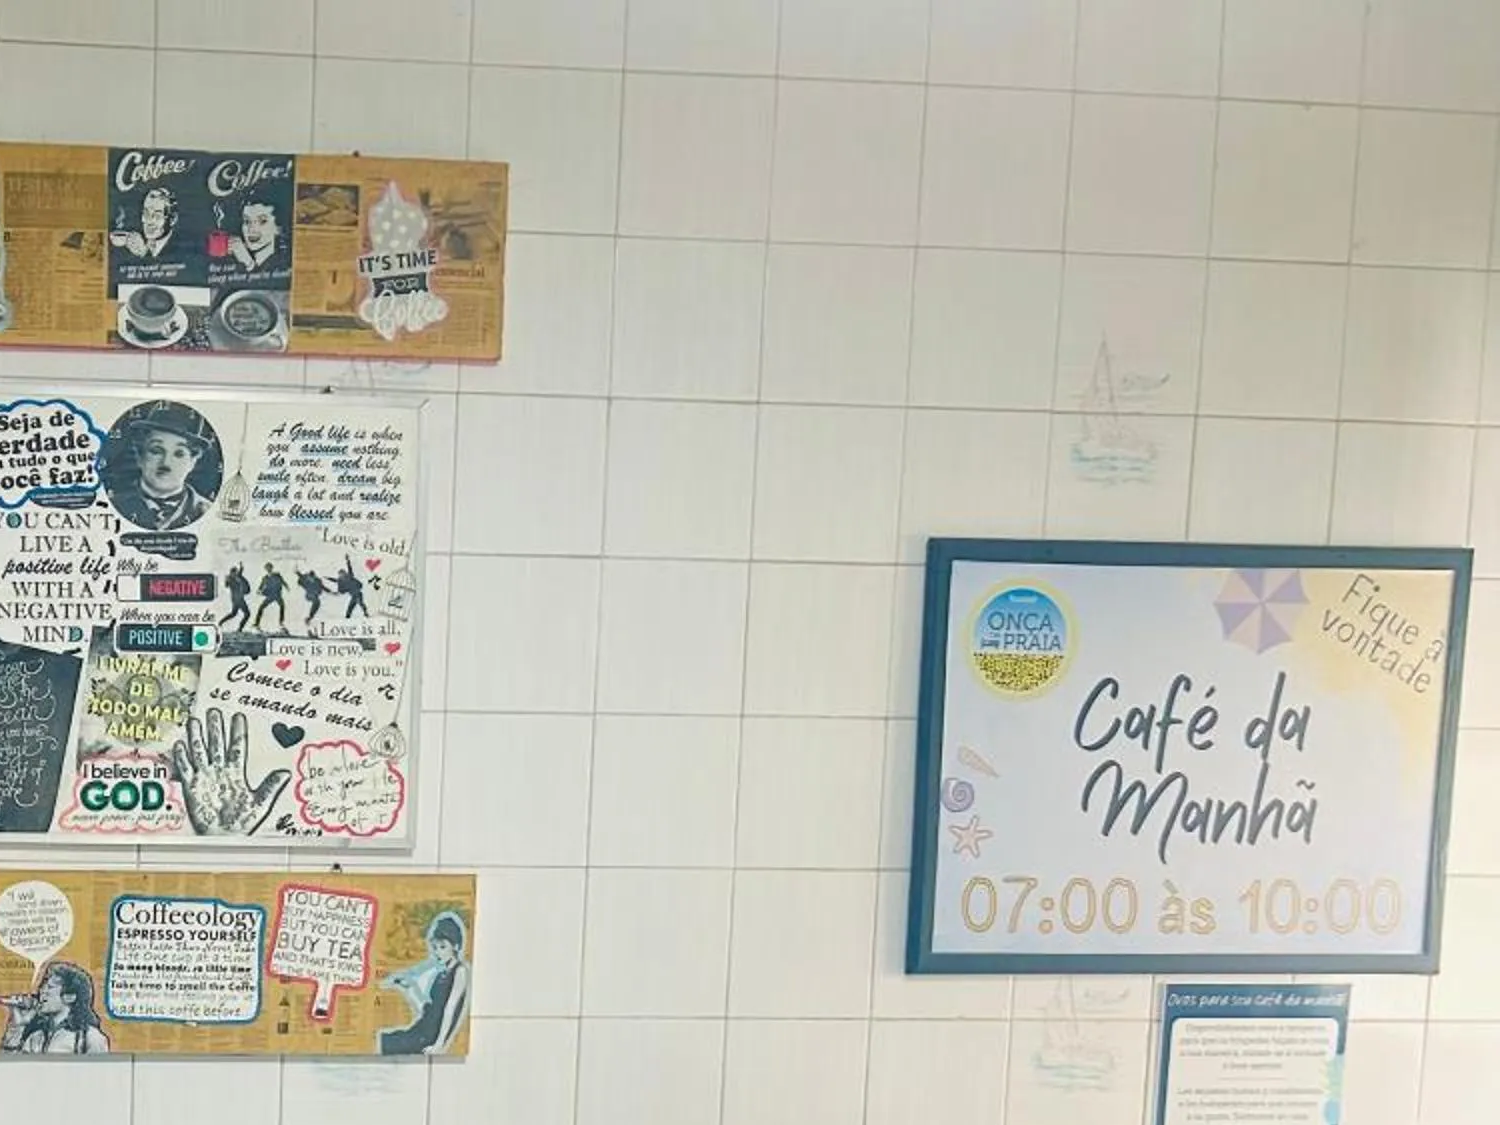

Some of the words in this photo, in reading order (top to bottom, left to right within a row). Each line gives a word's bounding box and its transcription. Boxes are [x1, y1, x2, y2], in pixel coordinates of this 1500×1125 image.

[359, 255, 392, 273] IT'S
[394, 250, 437, 269] TIME
[49, 410, 75, 427] de
[8, 454, 47, 468] tudo
[52, 455, 61, 464] o
[66, 452, 96, 466] que
[49, 464, 94, 486] faz!
[45, 511, 114, 530] CAN'T
[19, 535, 73, 553] LIVE
[77, 535, 93, 553] A
[1, 557, 73, 580] positive
[79, 555, 111, 581] life
[11, 581, 74, 598] WITH
[80, 581, 95, 598] A
[149, 579, 207, 596] NEGATIVE
[1342, 574, 1419, 645] Fique
[319, 621, 357, 637] Love
[987, 611, 1054, 634] ONÇA
[129, 629, 183, 645] POSITIVE
[1004, 633, 1062, 651] PRAIA
[1322, 609, 1431, 693] vontade
[304, 660, 342, 675] Love
[130, 682, 155, 697] DE
[227, 661, 304, 693] Comece
[310, 684, 321, 697] o
[329, 685, 363, 707] dia
[238, 692, 318, 719] amando
[325, 712, 373, 732] mais
[1074, 673, 1219, 774] Café
[1245, 671, 1311, 761] da
[91, 763, 150, 779] believe
[153, 763, 167, 779] in
[1081, 759, 1318, 865] Manhã
[287, 892, 320, 906] YOU
[960, 876, 1139, 935] 07:00
[1157, 878, 1218, 936] às
[1238, 877, 1401, 936] 10:00
[117, 928, 184, 941] ESPRESSO
[188, 928, 257, 942] YOURSELF
[309, 922, 339, 936] YOU
[278, 931, 320, 953] BUY
[327, 939, 363, 962] TEA
